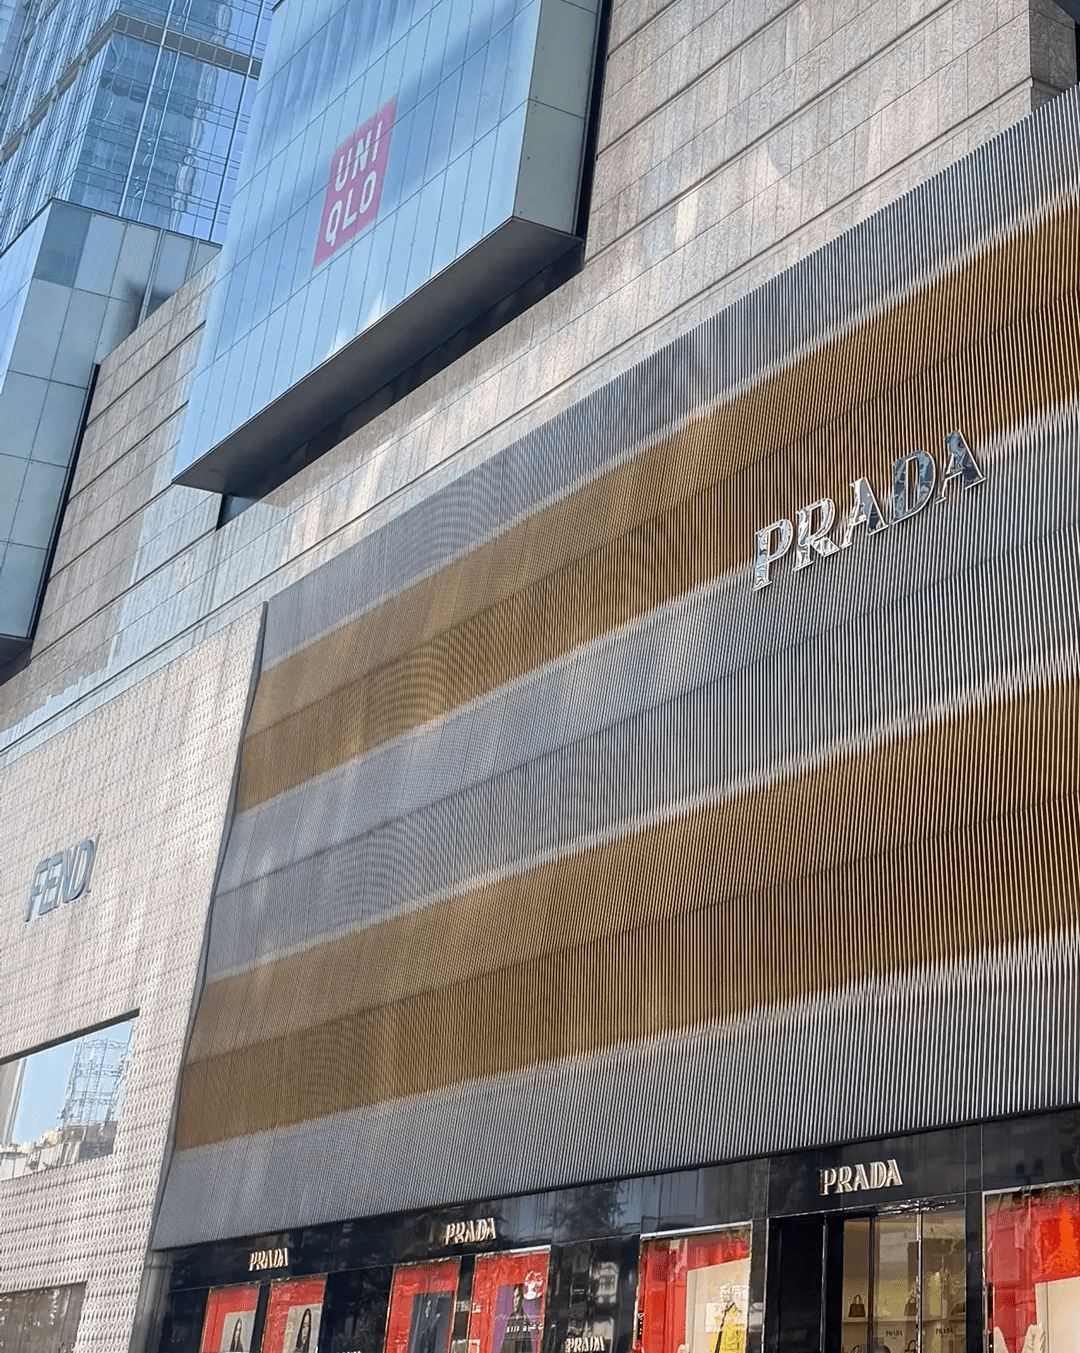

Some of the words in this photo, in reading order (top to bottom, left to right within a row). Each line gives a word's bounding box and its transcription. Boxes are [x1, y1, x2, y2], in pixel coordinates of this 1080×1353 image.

[334, 119, 383, 193] UNI
[325, 170, 377, 247] QLO
[752, 429, 986, 591] PRADA
[25, 833, 101, 922] FENDI
[819, 1158, 903, 1196] PRADA
[445, 1217, 497, 1245] PRADA
[248, 1247, 289, 1272] PRADA
[564, 1336, 605, 1353] PRADA
